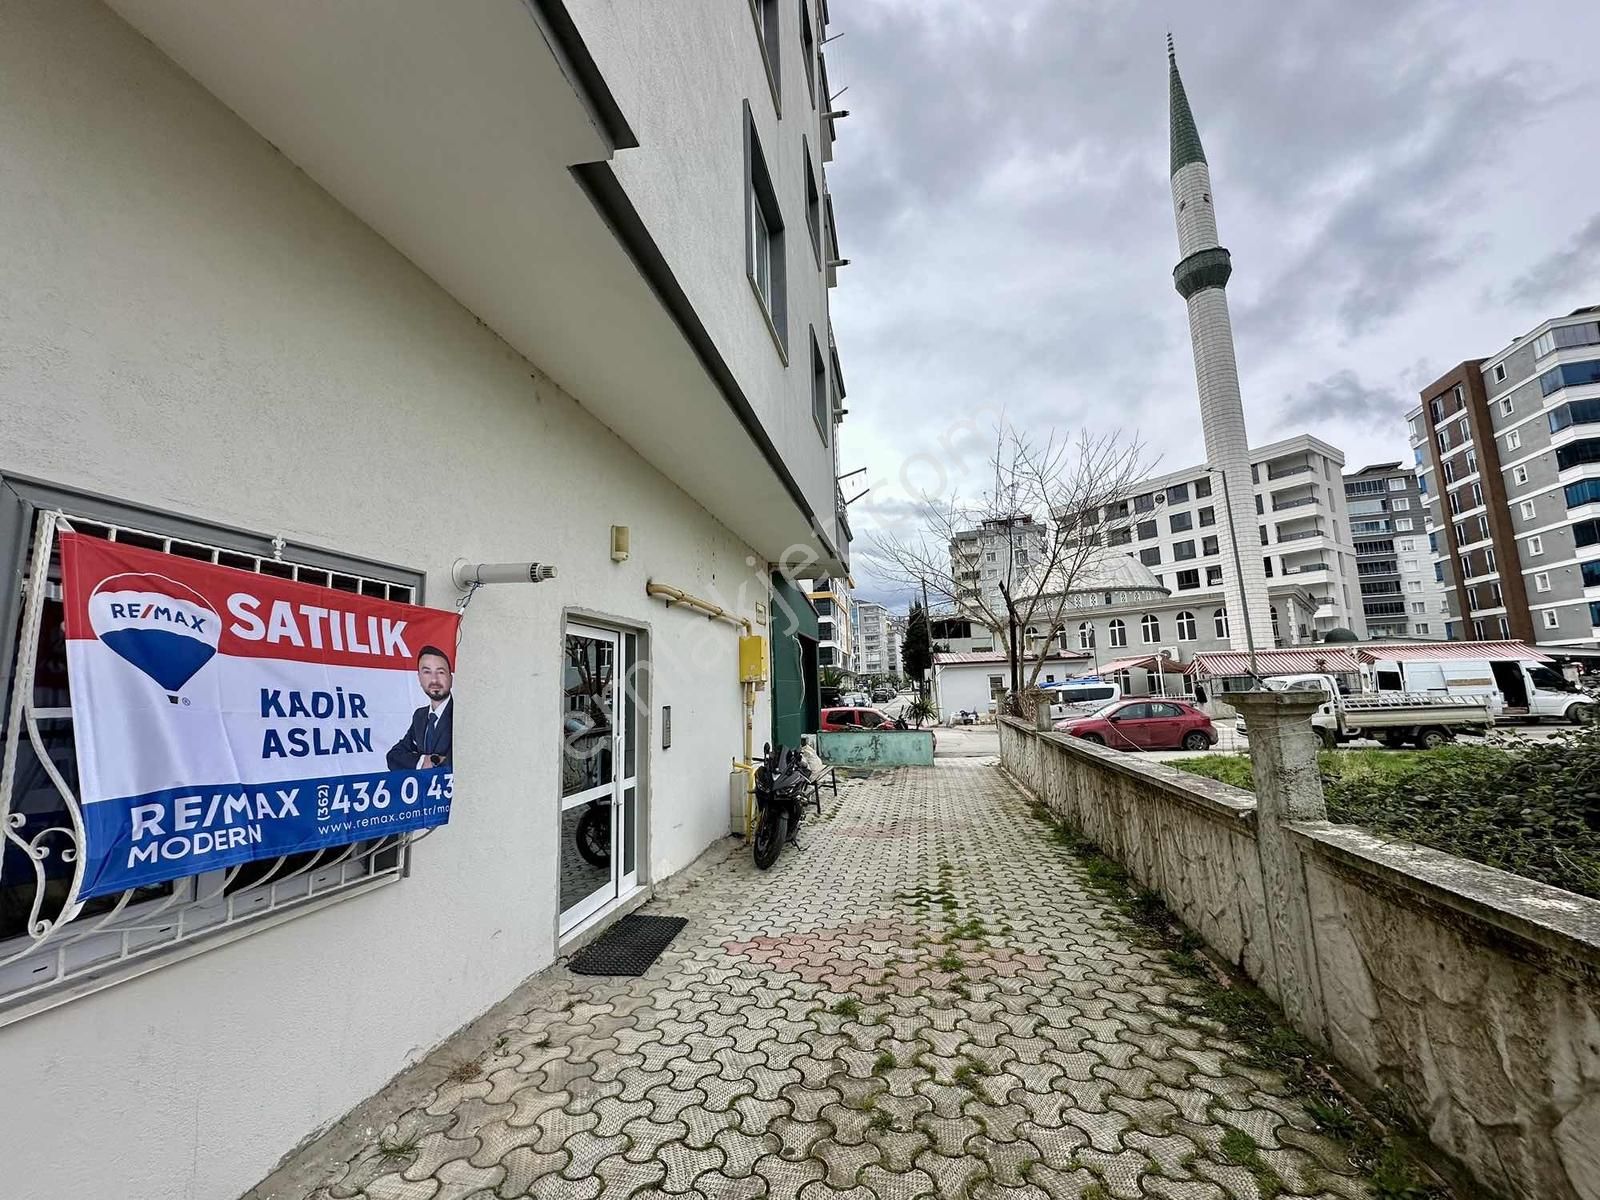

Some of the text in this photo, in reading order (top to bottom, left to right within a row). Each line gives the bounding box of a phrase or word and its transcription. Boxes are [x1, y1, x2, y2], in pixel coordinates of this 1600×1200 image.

[110, 603, 206, 634] RE/MAX
[226, 592, 412, 658] SATILIK
[260, 686, 369, 719] KADİR
[261, 727, 374, 759] ASLAN
[130, 788, 300, 841] RE/MAX
[316, 784, 331, 821] (362)
[331, 779, 391, 814] 436
[400, 776, 419, 805] 0
[127, 823, 262, 869] MODERN
